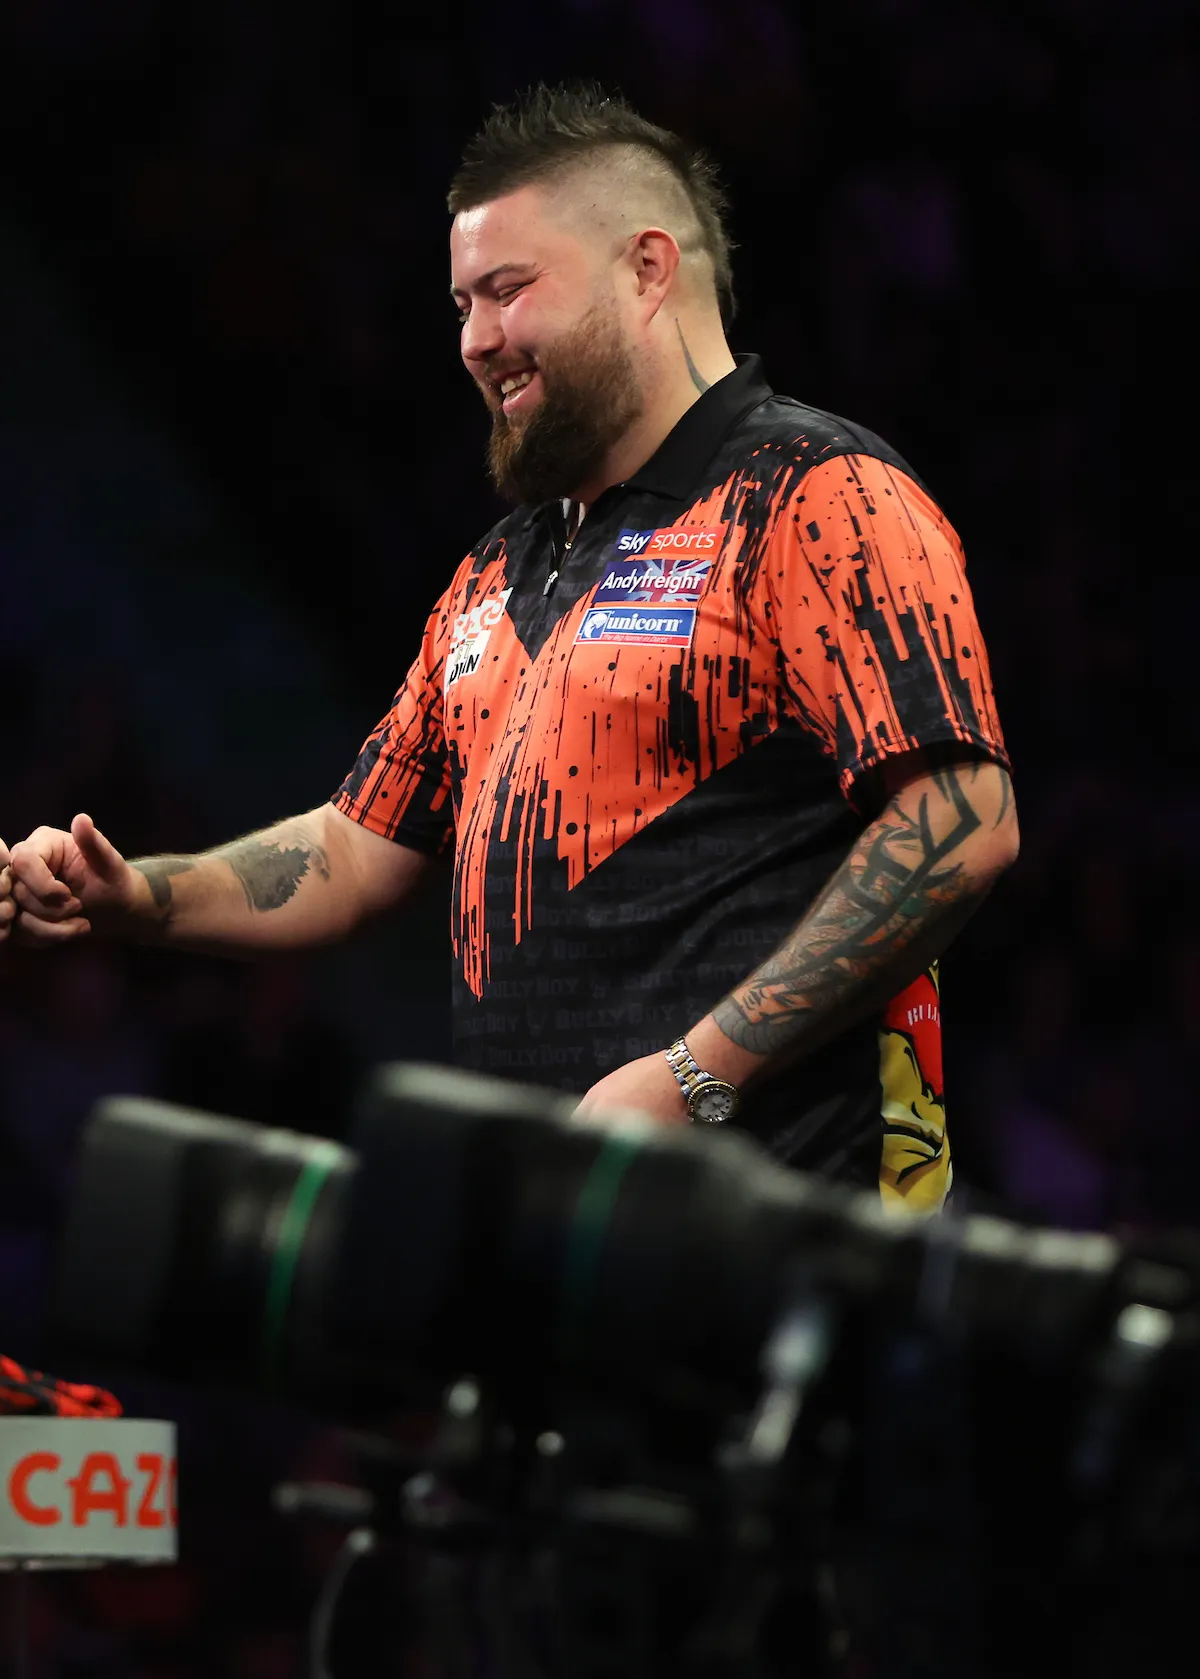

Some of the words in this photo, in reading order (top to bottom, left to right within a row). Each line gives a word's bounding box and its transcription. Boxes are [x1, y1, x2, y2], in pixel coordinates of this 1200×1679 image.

[618, 533, 651, 554] sky
[651, 531, 717, 551] sports
[600, 567, 701, 594] Andyfreight
[607, 613, 679, 632] unicorn
